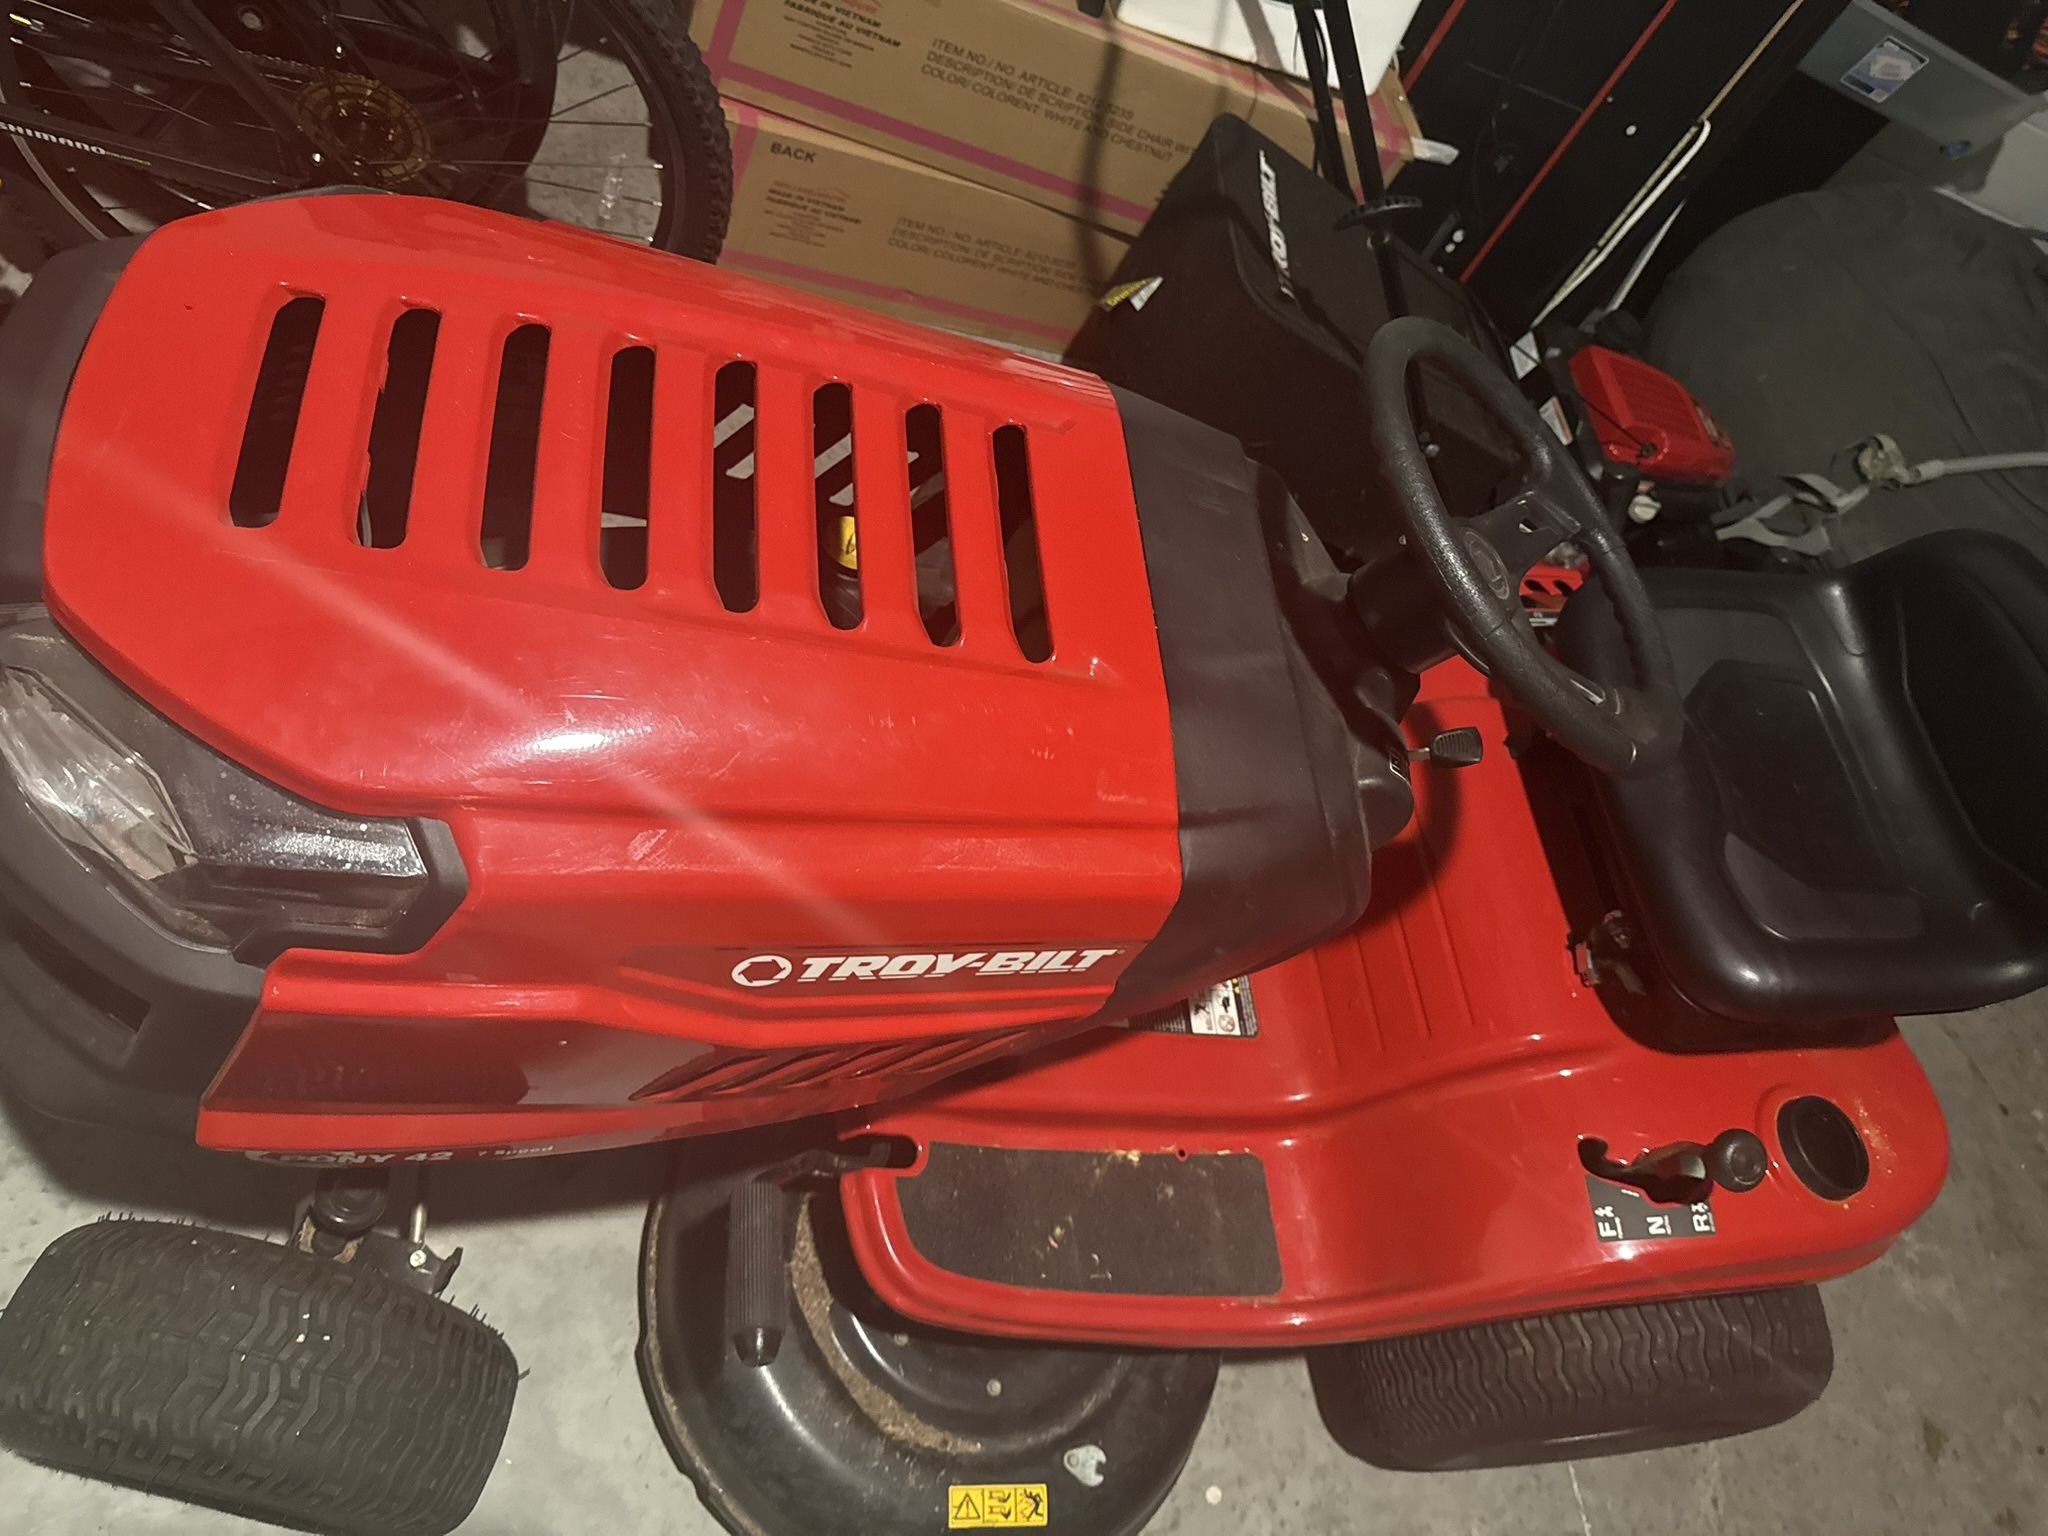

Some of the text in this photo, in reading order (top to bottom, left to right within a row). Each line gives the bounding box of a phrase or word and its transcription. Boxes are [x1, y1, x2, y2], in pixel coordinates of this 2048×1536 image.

[932, 38, 965, 57] ITEM
[769, 141, 817, 163] BACK
[797, 948, 1117, 982] TROY-BILT
[404, 1151, 453, 1162] 42
[1598, 1221, 1618, 1238] F
[1646, 1216, 1666, 1235] N
